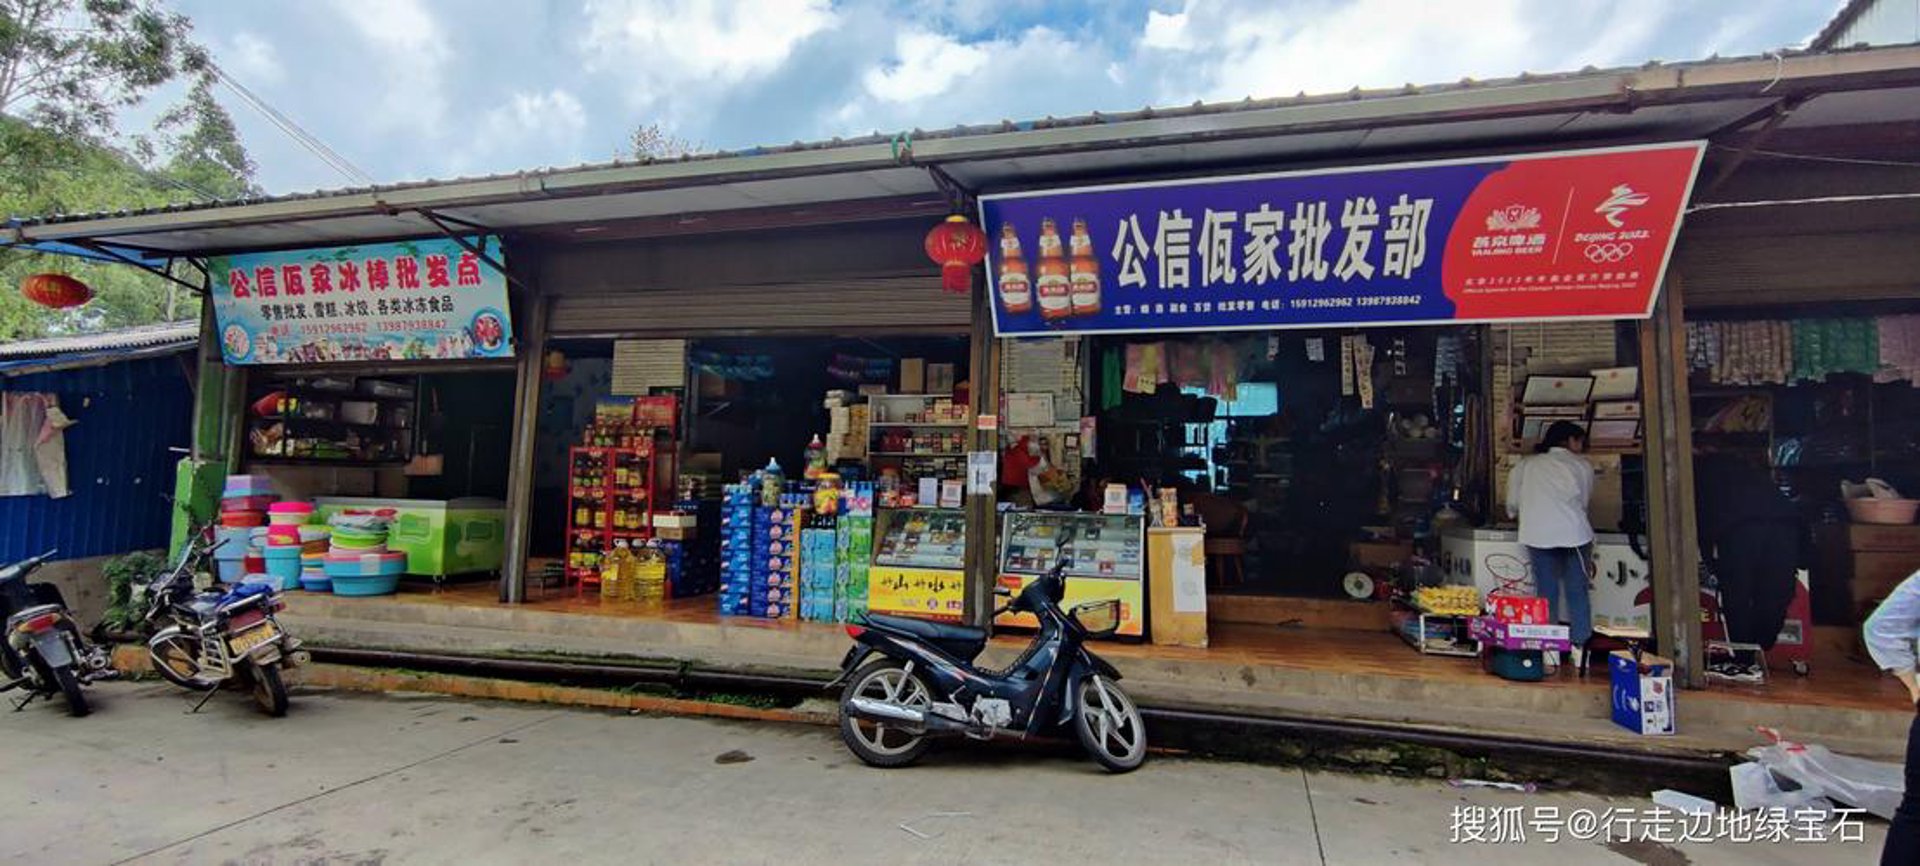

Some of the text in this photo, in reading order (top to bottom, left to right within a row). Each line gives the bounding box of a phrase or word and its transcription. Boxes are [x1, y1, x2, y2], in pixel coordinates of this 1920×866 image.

[1112, 194, 1434, 289] 公信佤家批发部
[1574, 232, 1616, 243] BEIJING
[1515, 246, 1543, 254] BEER
